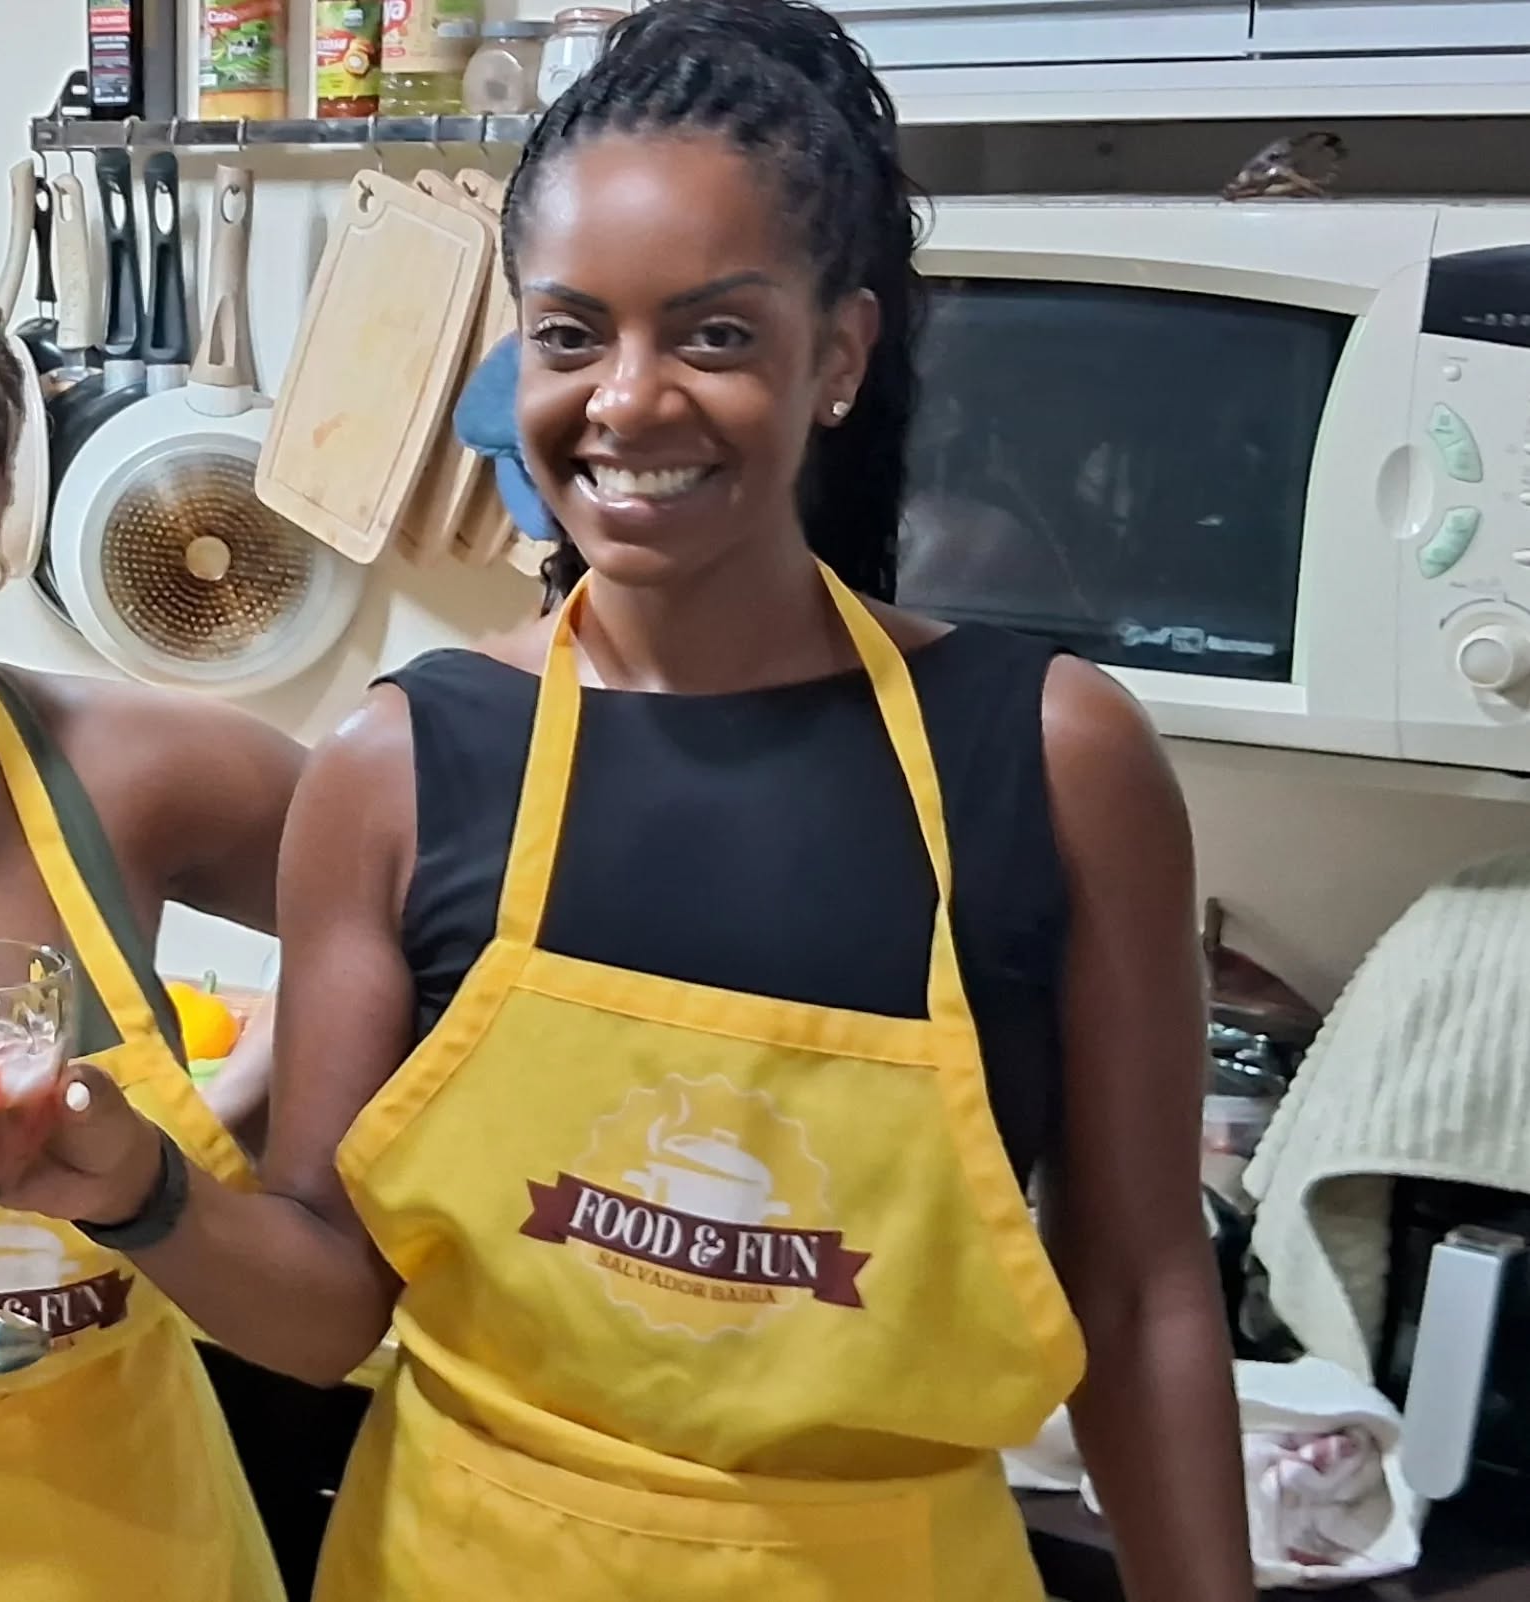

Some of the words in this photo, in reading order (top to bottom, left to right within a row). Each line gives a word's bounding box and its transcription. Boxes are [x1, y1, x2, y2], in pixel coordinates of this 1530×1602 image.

[569, 1187, 682, 1258] FOOD
[689, 1224, 726, 1269] &
[734, 1231, 820, 1280] FUN
[597, 1251, 707, 1298] SALVADOR
